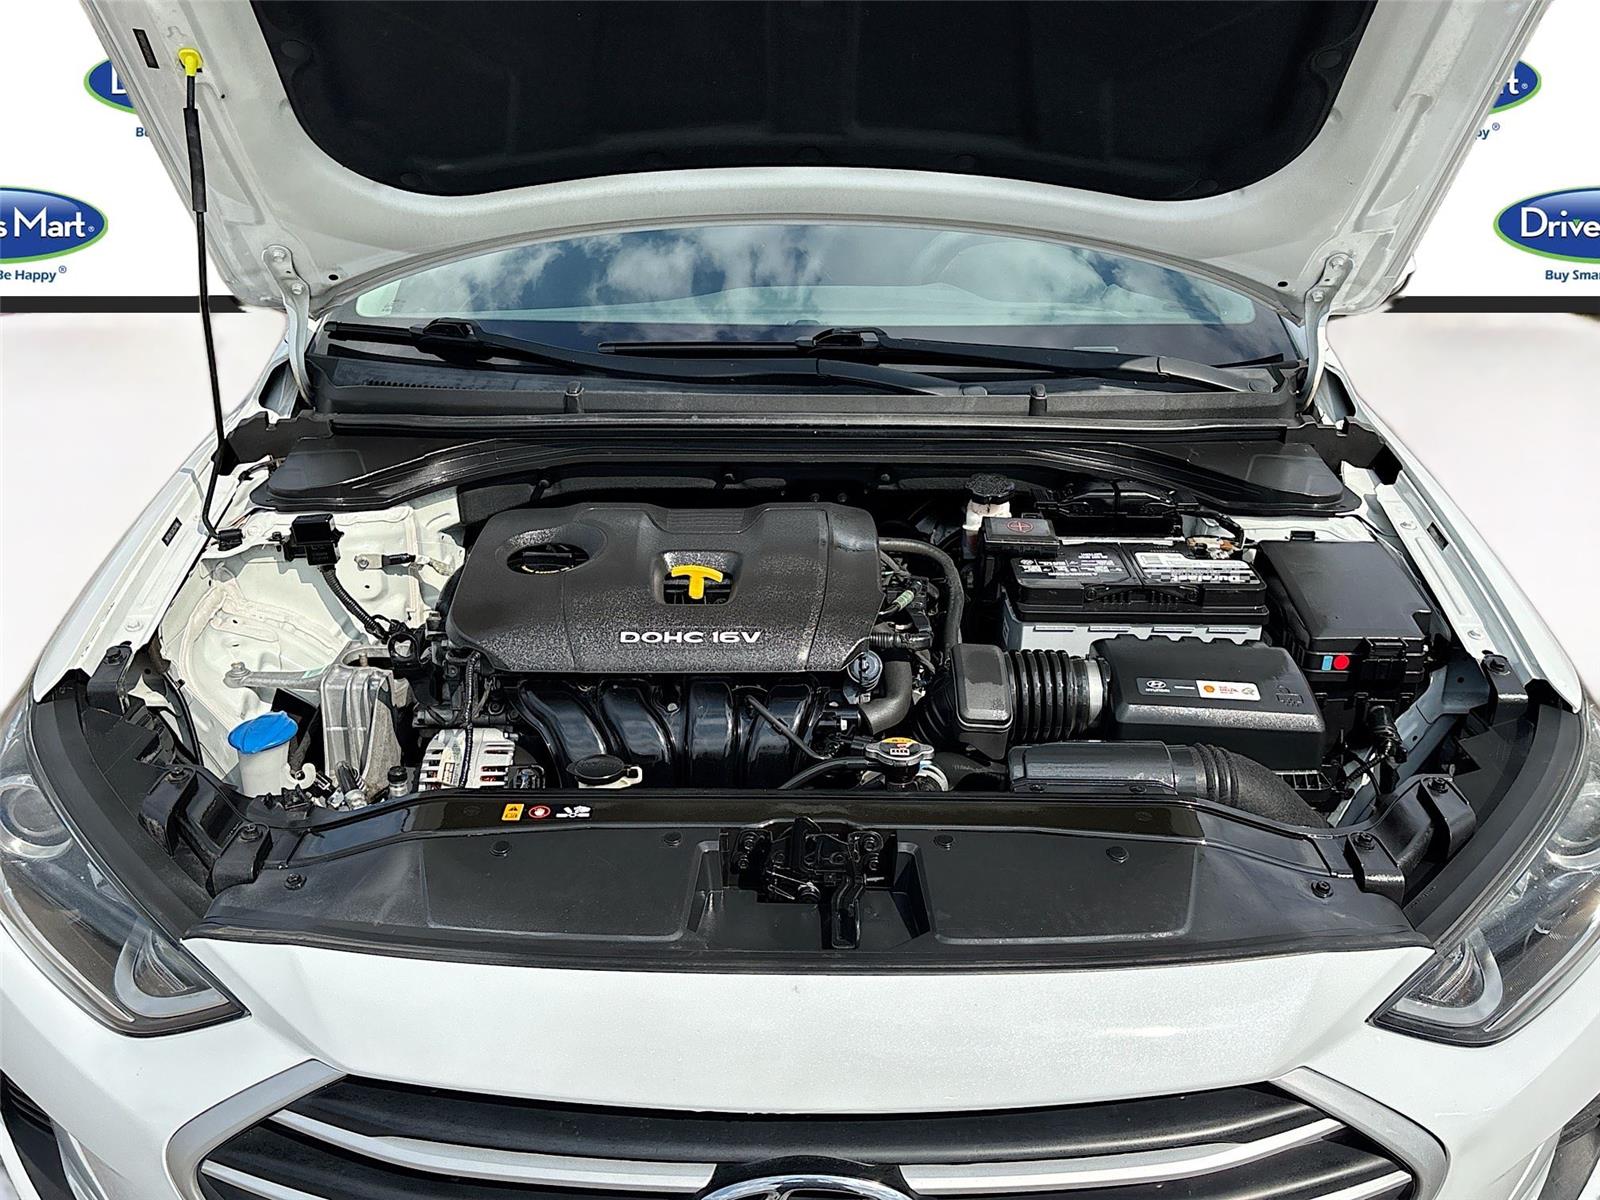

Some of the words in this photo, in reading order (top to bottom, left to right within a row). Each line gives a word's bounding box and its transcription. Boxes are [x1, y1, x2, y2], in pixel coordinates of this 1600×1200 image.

[14, 207, 86, 238] Mart
[15, 270, 57, 283] Happy
[1545, 270, 1570, 283] Buy
[620, 631, 704, 643] DOHC
[712, 631, 761, 643] 16V
